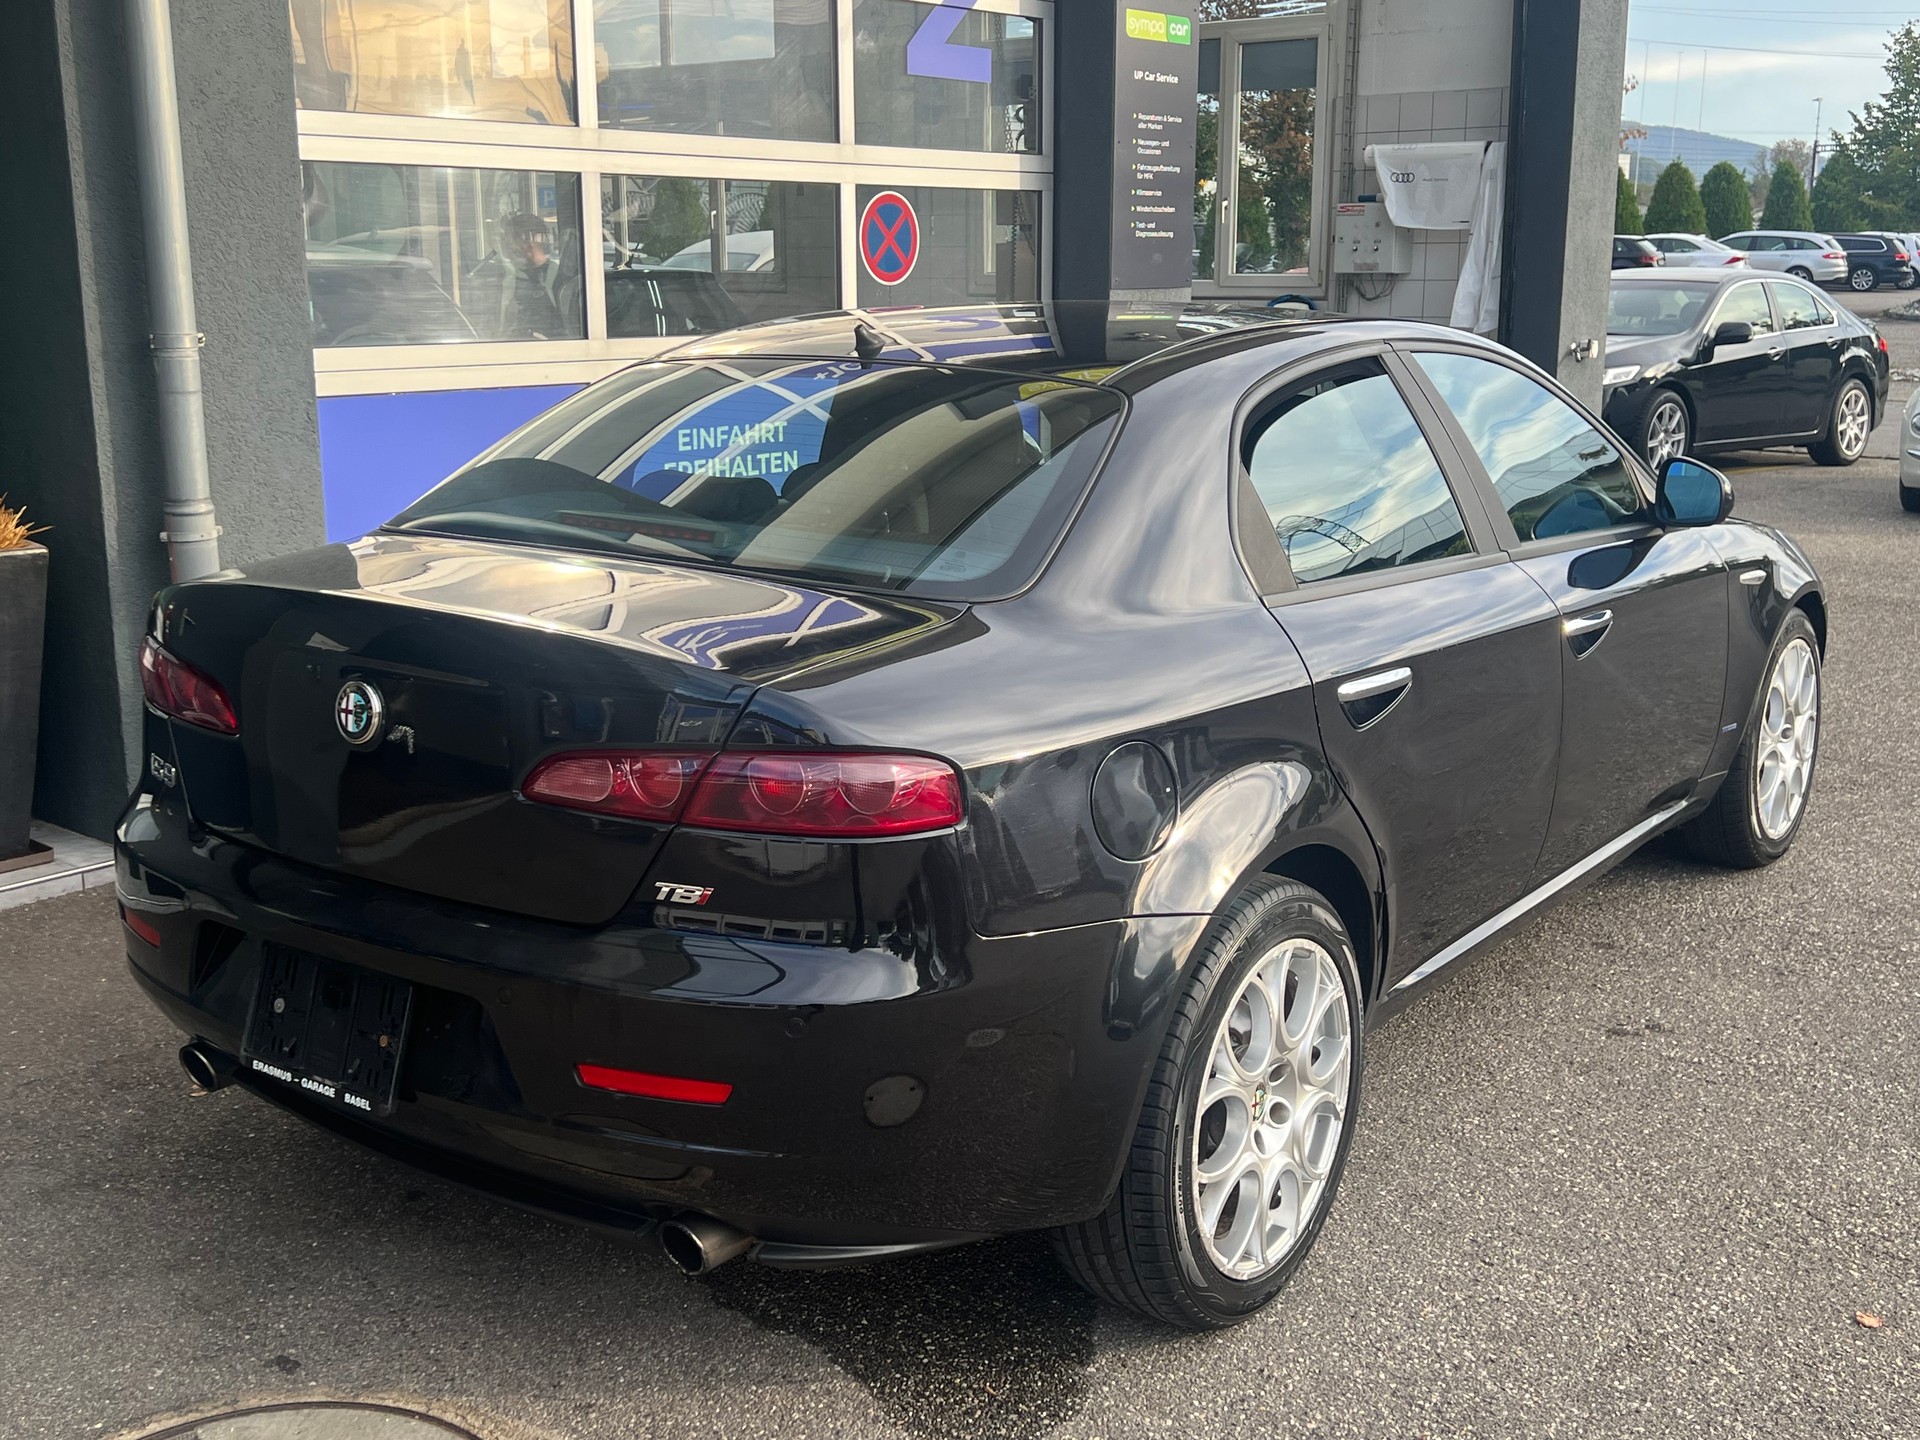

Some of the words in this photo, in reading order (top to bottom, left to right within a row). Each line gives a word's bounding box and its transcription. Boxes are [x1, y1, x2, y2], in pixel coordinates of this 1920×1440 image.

[1169, 23, 1188, 36] car
[1134, 70, 1144, 80] UP
[1144, 71, 1156, 82] Car
[1156, 73, 1179, 84] Service
[1167, 115, 1183, 123] Service
[678, 421, 788, 452] EINFAHRT
[252, 1059, 292, 1083] ERASMUS
[300, 1077, 336, 1098] GARAGE
[344, 1092, 372, 1112] BASEL
